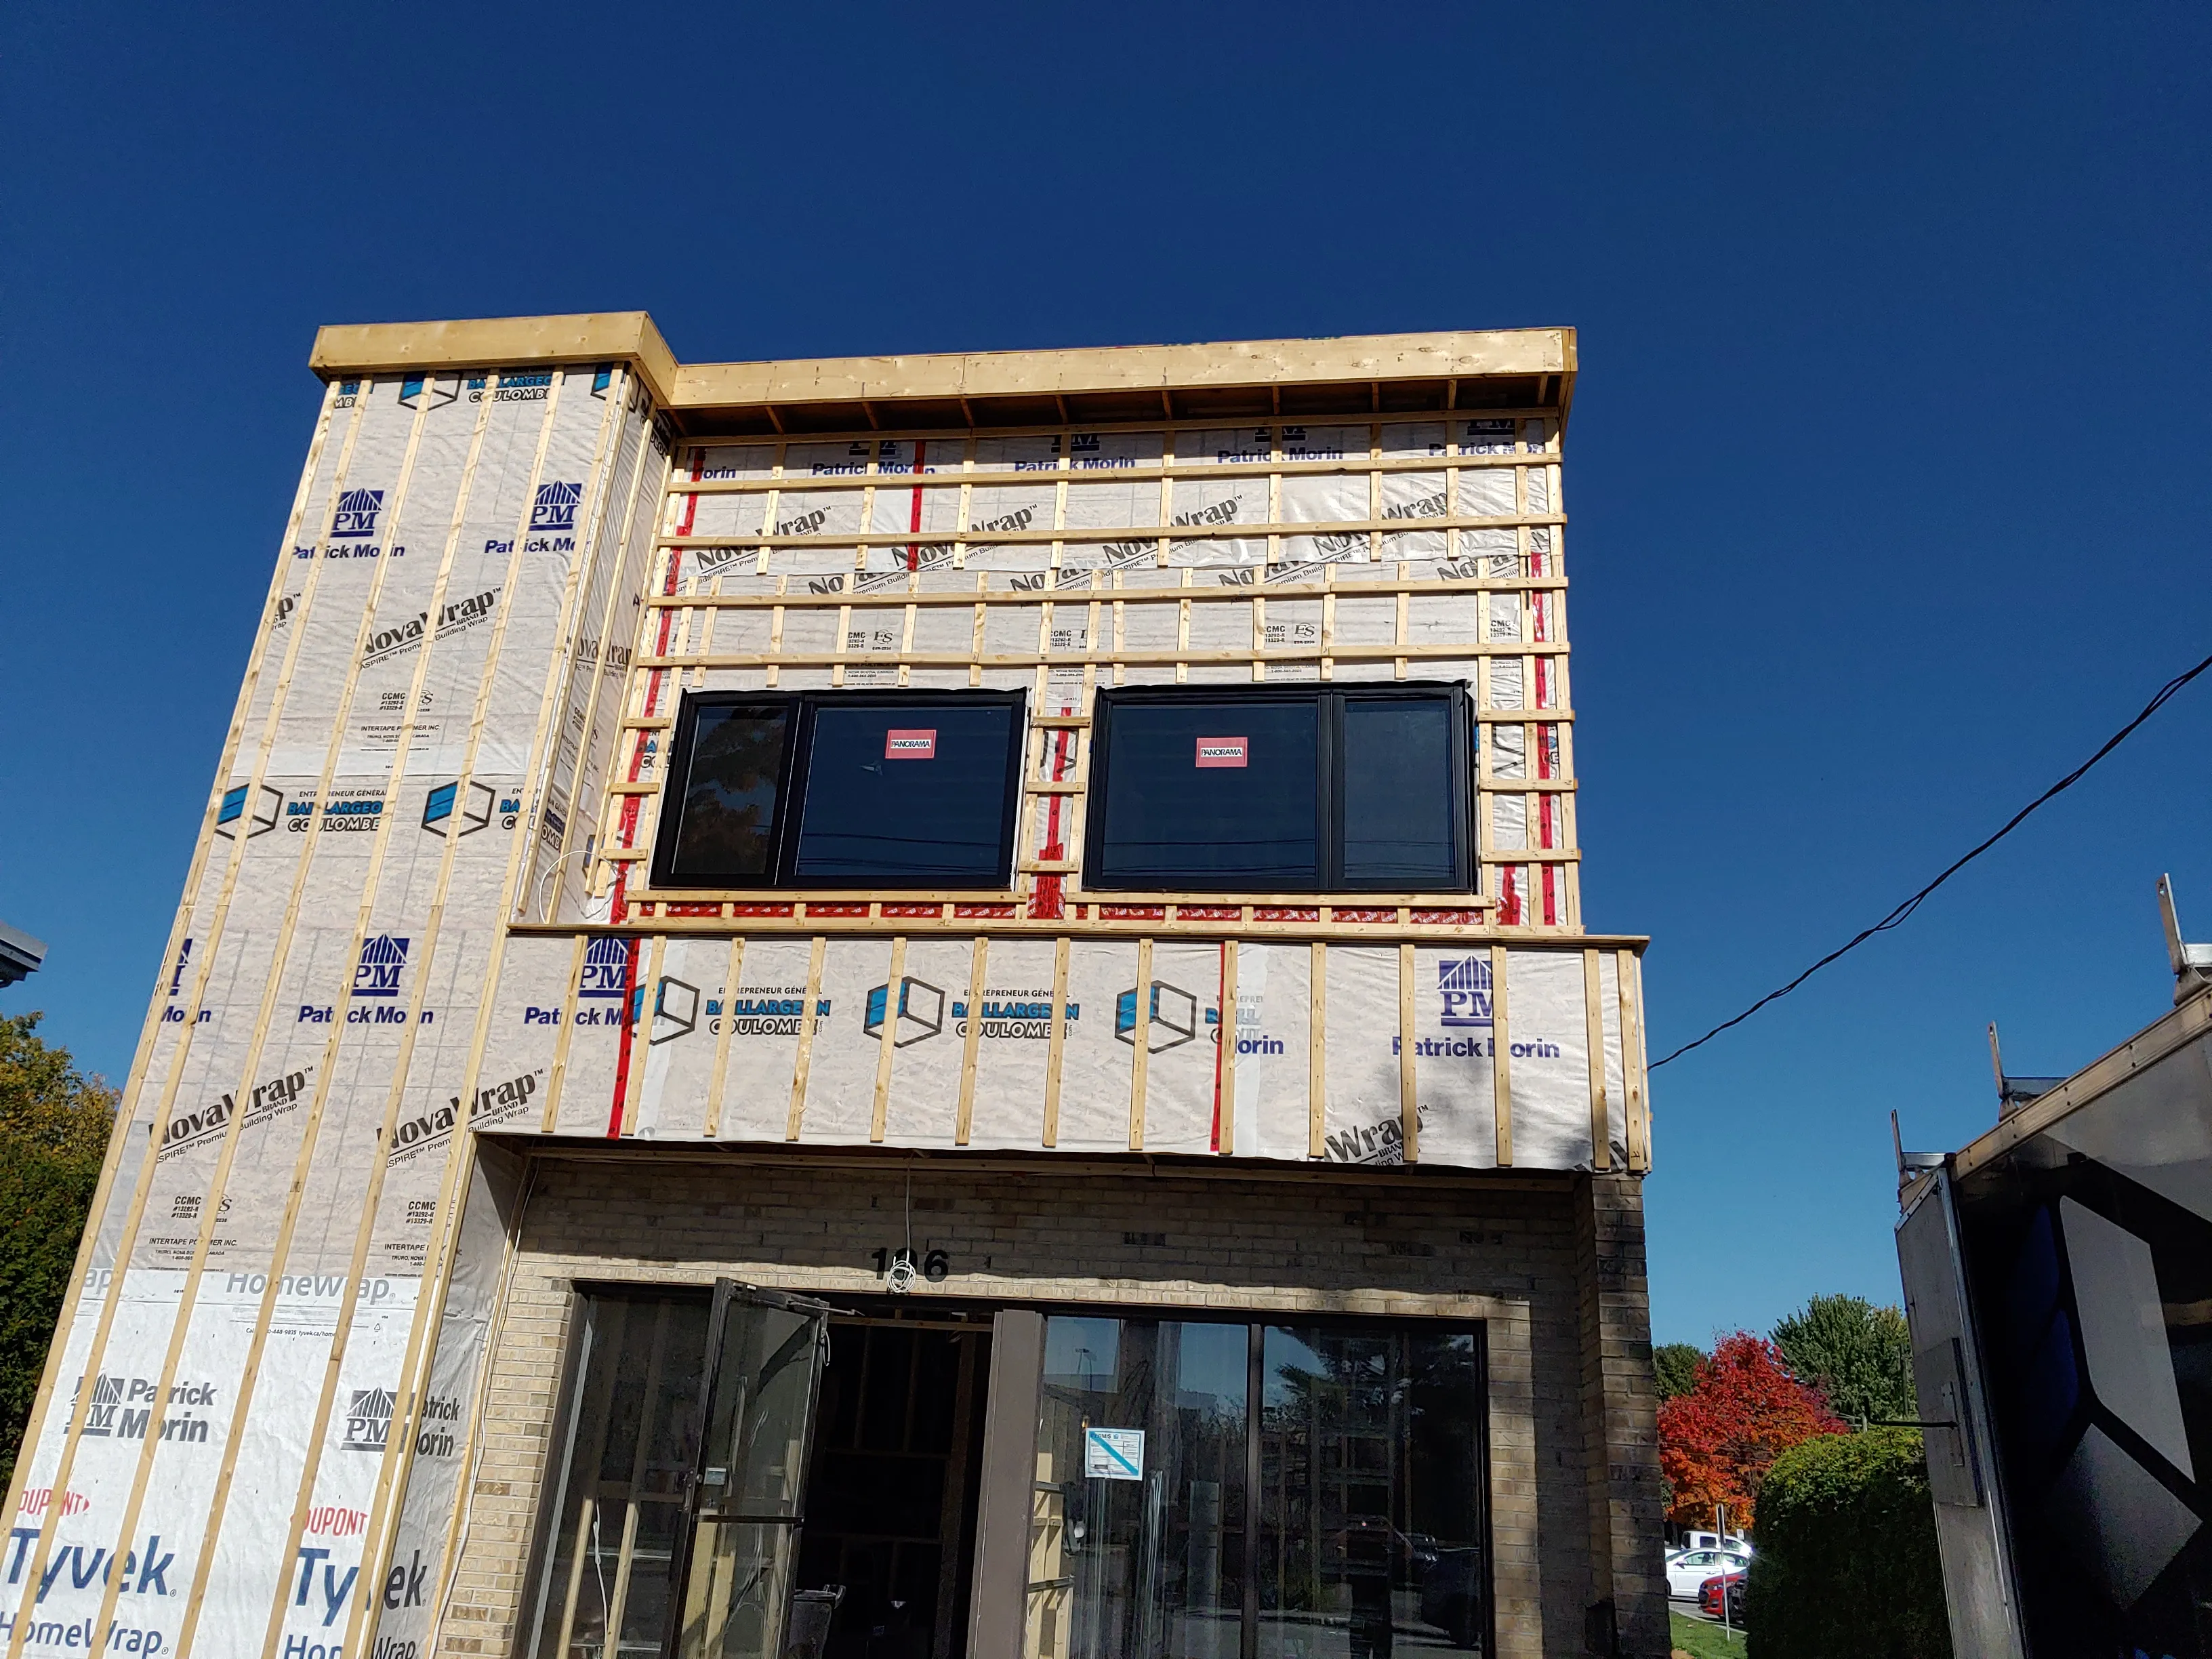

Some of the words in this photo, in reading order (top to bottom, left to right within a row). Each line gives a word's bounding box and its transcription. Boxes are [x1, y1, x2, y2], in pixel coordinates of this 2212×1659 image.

[469, 388, 551, 403] CULOMB
[1218, 449, 1286, 464] Patric
[1289, 446, 1344, 461] Morin
[813, 463, 868, 475] Patric
[293, 544, 351, 559] Patick
[353, 543, 405, 558] Moin
[484, 538, 550, 554] Patick
[434, 624, 467, 642] Building
[467, 616, 488, 629] Wrap
[356, 789, 388, 797] GÉNÉRA
[353, 964, 405, 988] PM
[581, 965, 628, 989] PM
[784, 985, 823, 995] GÉNÉL
[298, 1004, 373, 1024] Patck
[374, 1006, 434, 1024] Mon
[523, 1006, 602, 1026] Patck
[709, 1018, 819, 1036] CULOMB
[956, 1021, 1068, 1040] CULOMB
[262, 1098, 288, 1113] BRAND
[491, 1100, 519, 1116] BRAND
[197, 1131, 228, 1149] Premiu
[274, 1103, 298, 1118] Wrap
[427, 1135, 453, 1152] Prem
[468, 1115, 504, 1133] Building
[504, 1106, 530, 1121] Wrap
[1378, 1143, 1403, 1157] BRAN
[175, 1196, 201, 1205] CCMC
[408, 1201, 436, 1210] CCMC
[127, 1378, 218, 1406] Parick
[18, 1488, 83, 1517] DUPNT
